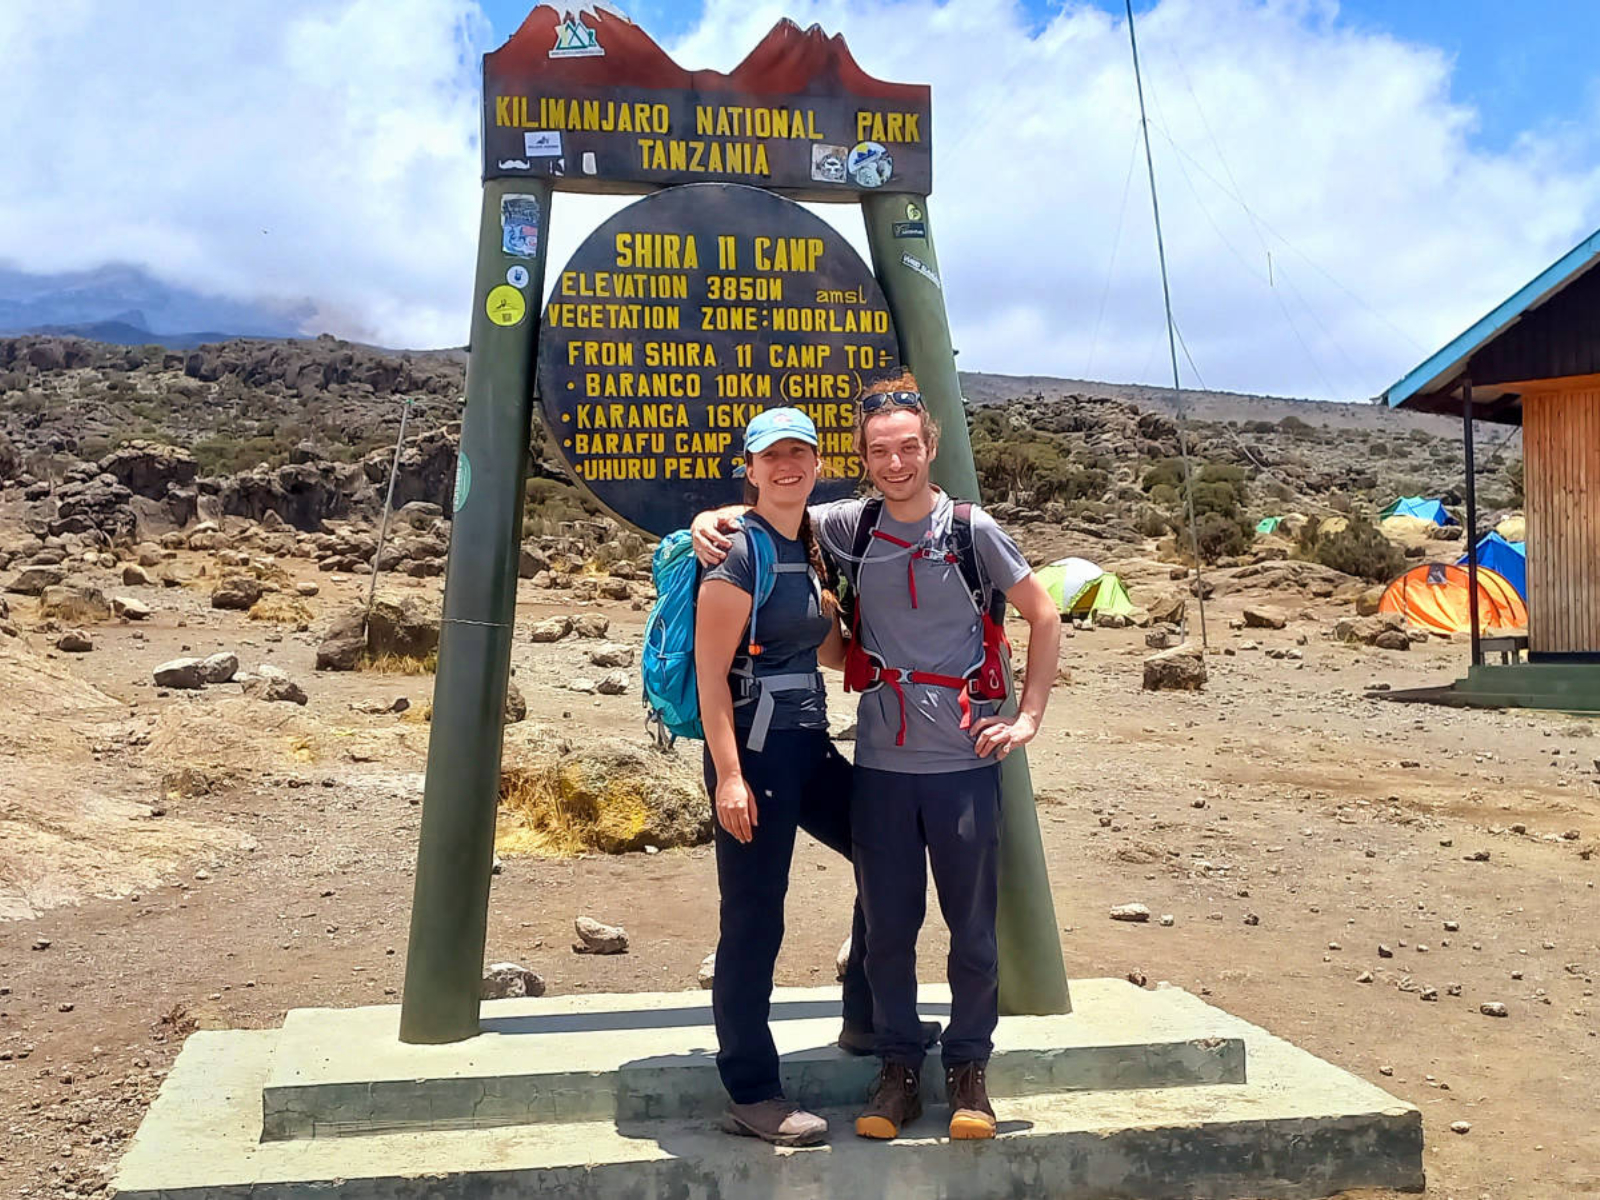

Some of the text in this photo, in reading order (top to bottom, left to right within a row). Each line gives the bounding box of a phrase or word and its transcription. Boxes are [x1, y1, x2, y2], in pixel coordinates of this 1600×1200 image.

[495, 96, 920, 142] KILIMANJARO NATIONAL PARK
[639, 139, 769, 175] TANZANIA
[615, 233, 698, 268] SHIRA
[754, 237, 824, 272] CAMP
[562, 271, 688, 298] ELEVATION
[707, 277, 782, 301] 3850M
[548, 304, 680, 330] VEGETATION
[568, 341, 634, 366] FROM
[645, 343, 717, 368] SHIRA
[769, 345, 831, 369] CAMP
[585, 371, 862, 402] BARANCO 10KM (6HRS)
[577, 404, 689, 428] KARANGA
[575, 433, 665, 454] BARAFU
[675, 432, 732, 454] CAMP
[583, 458, 657, 480] UHURU
[664, 457, 721, 478] PEAK
